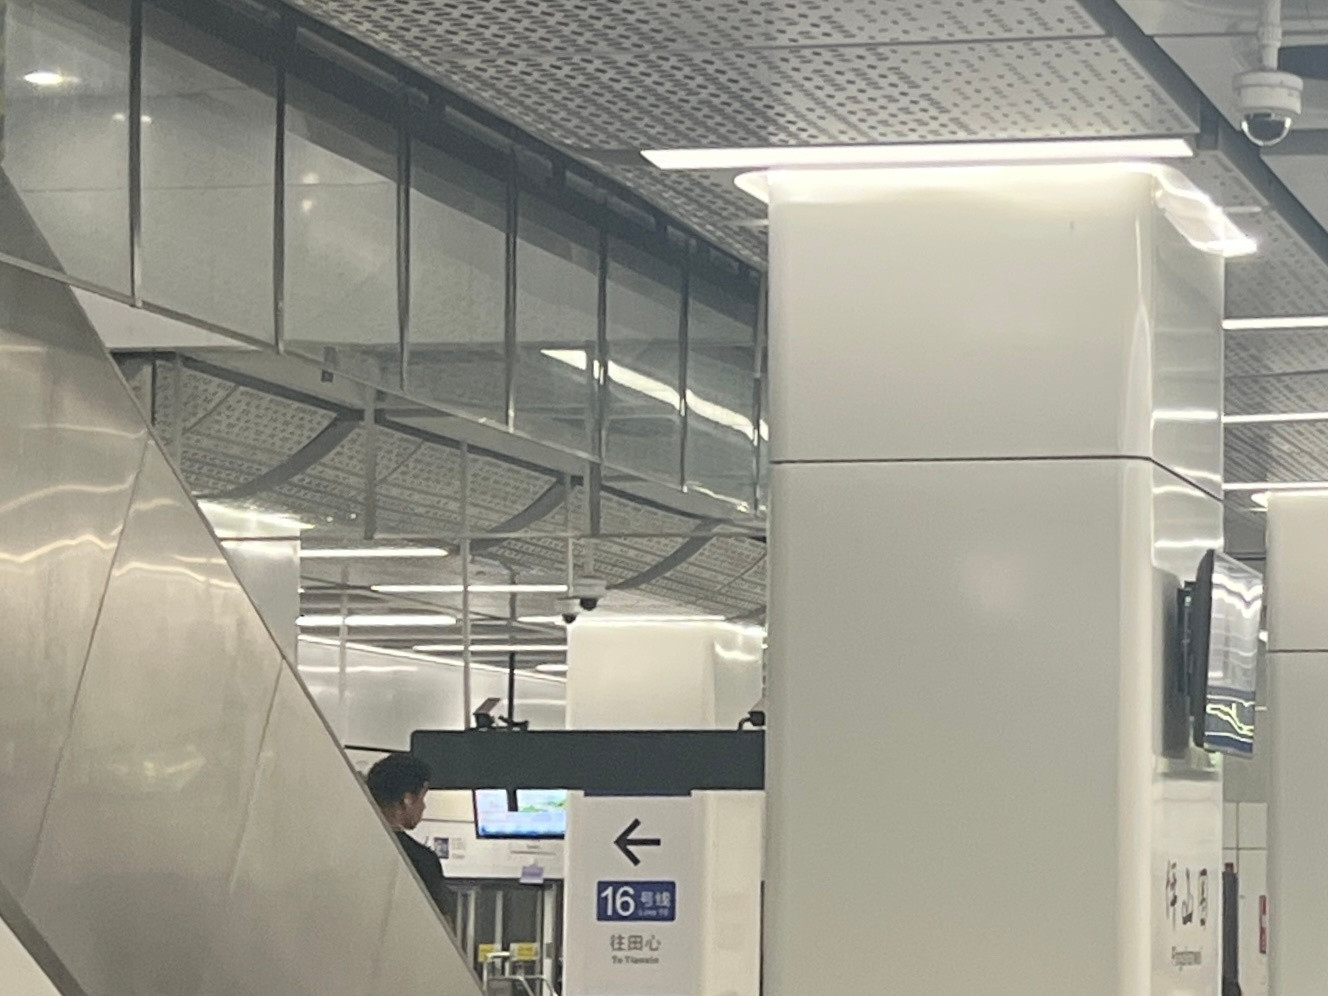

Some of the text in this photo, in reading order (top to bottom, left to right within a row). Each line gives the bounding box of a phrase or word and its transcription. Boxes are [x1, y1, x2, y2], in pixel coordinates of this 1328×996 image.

[600, 886, 635, 916] 16
[610, 934, 661, 951] 往田心
